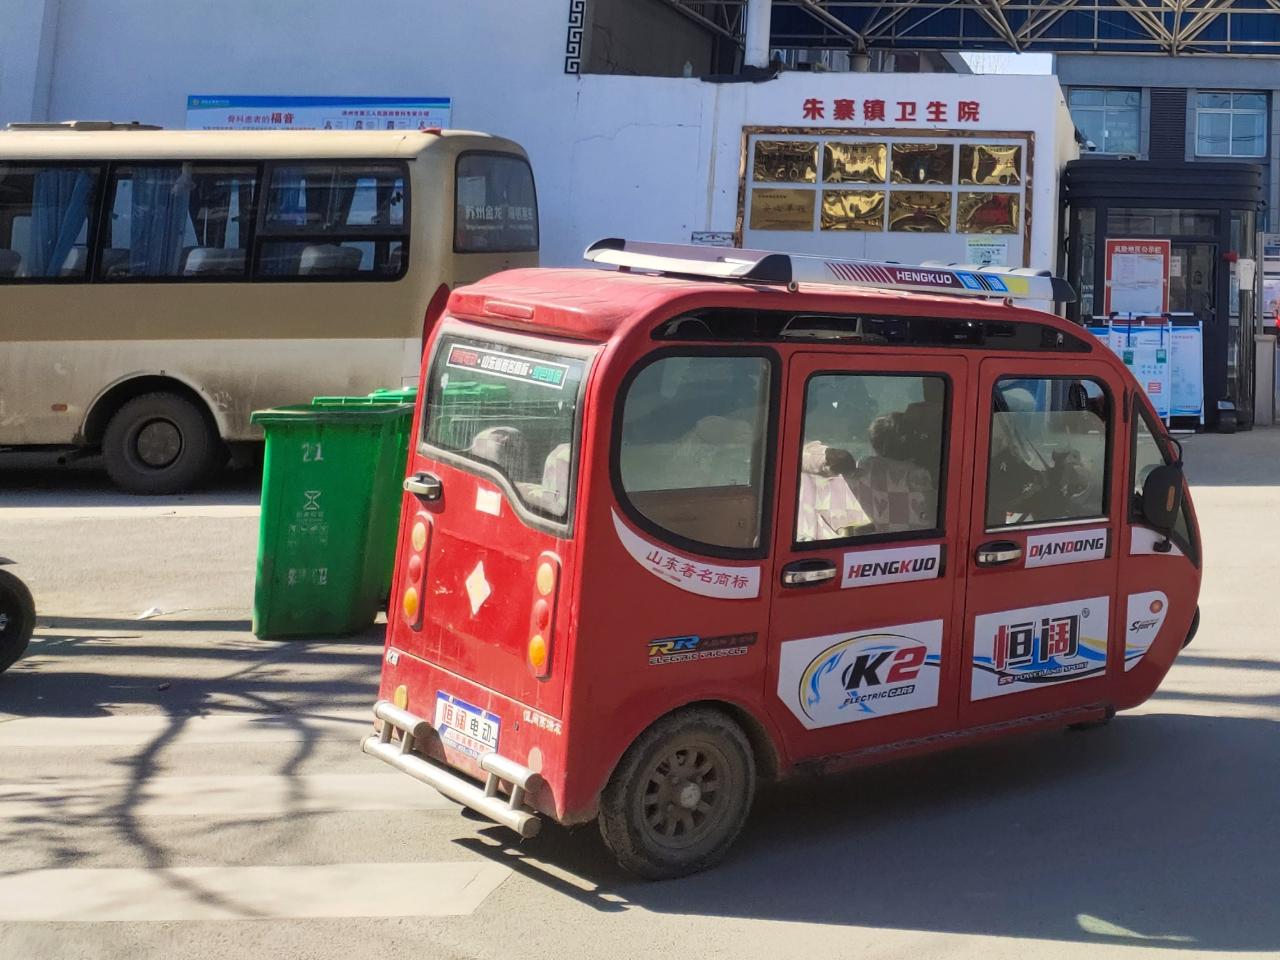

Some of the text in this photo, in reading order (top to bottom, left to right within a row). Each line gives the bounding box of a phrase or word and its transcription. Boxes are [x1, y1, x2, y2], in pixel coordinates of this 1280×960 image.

[803, 98, 980, 122] 朱寨镇卫生院
[1114, 245, 1162, 254] 风险地区公示栏
[896, 270, 952, 284] HENGKUO
[301, 442, 324, 462] 21
[1029, 537, 1104, 560] DIANDONG
[645, 550, 750, 589] 山东著名商标
[992, 613, 1081, 671] 恒阔
[845, 645, 928, 691] K2
[843, 691, 888, 706] ELECTRIC
